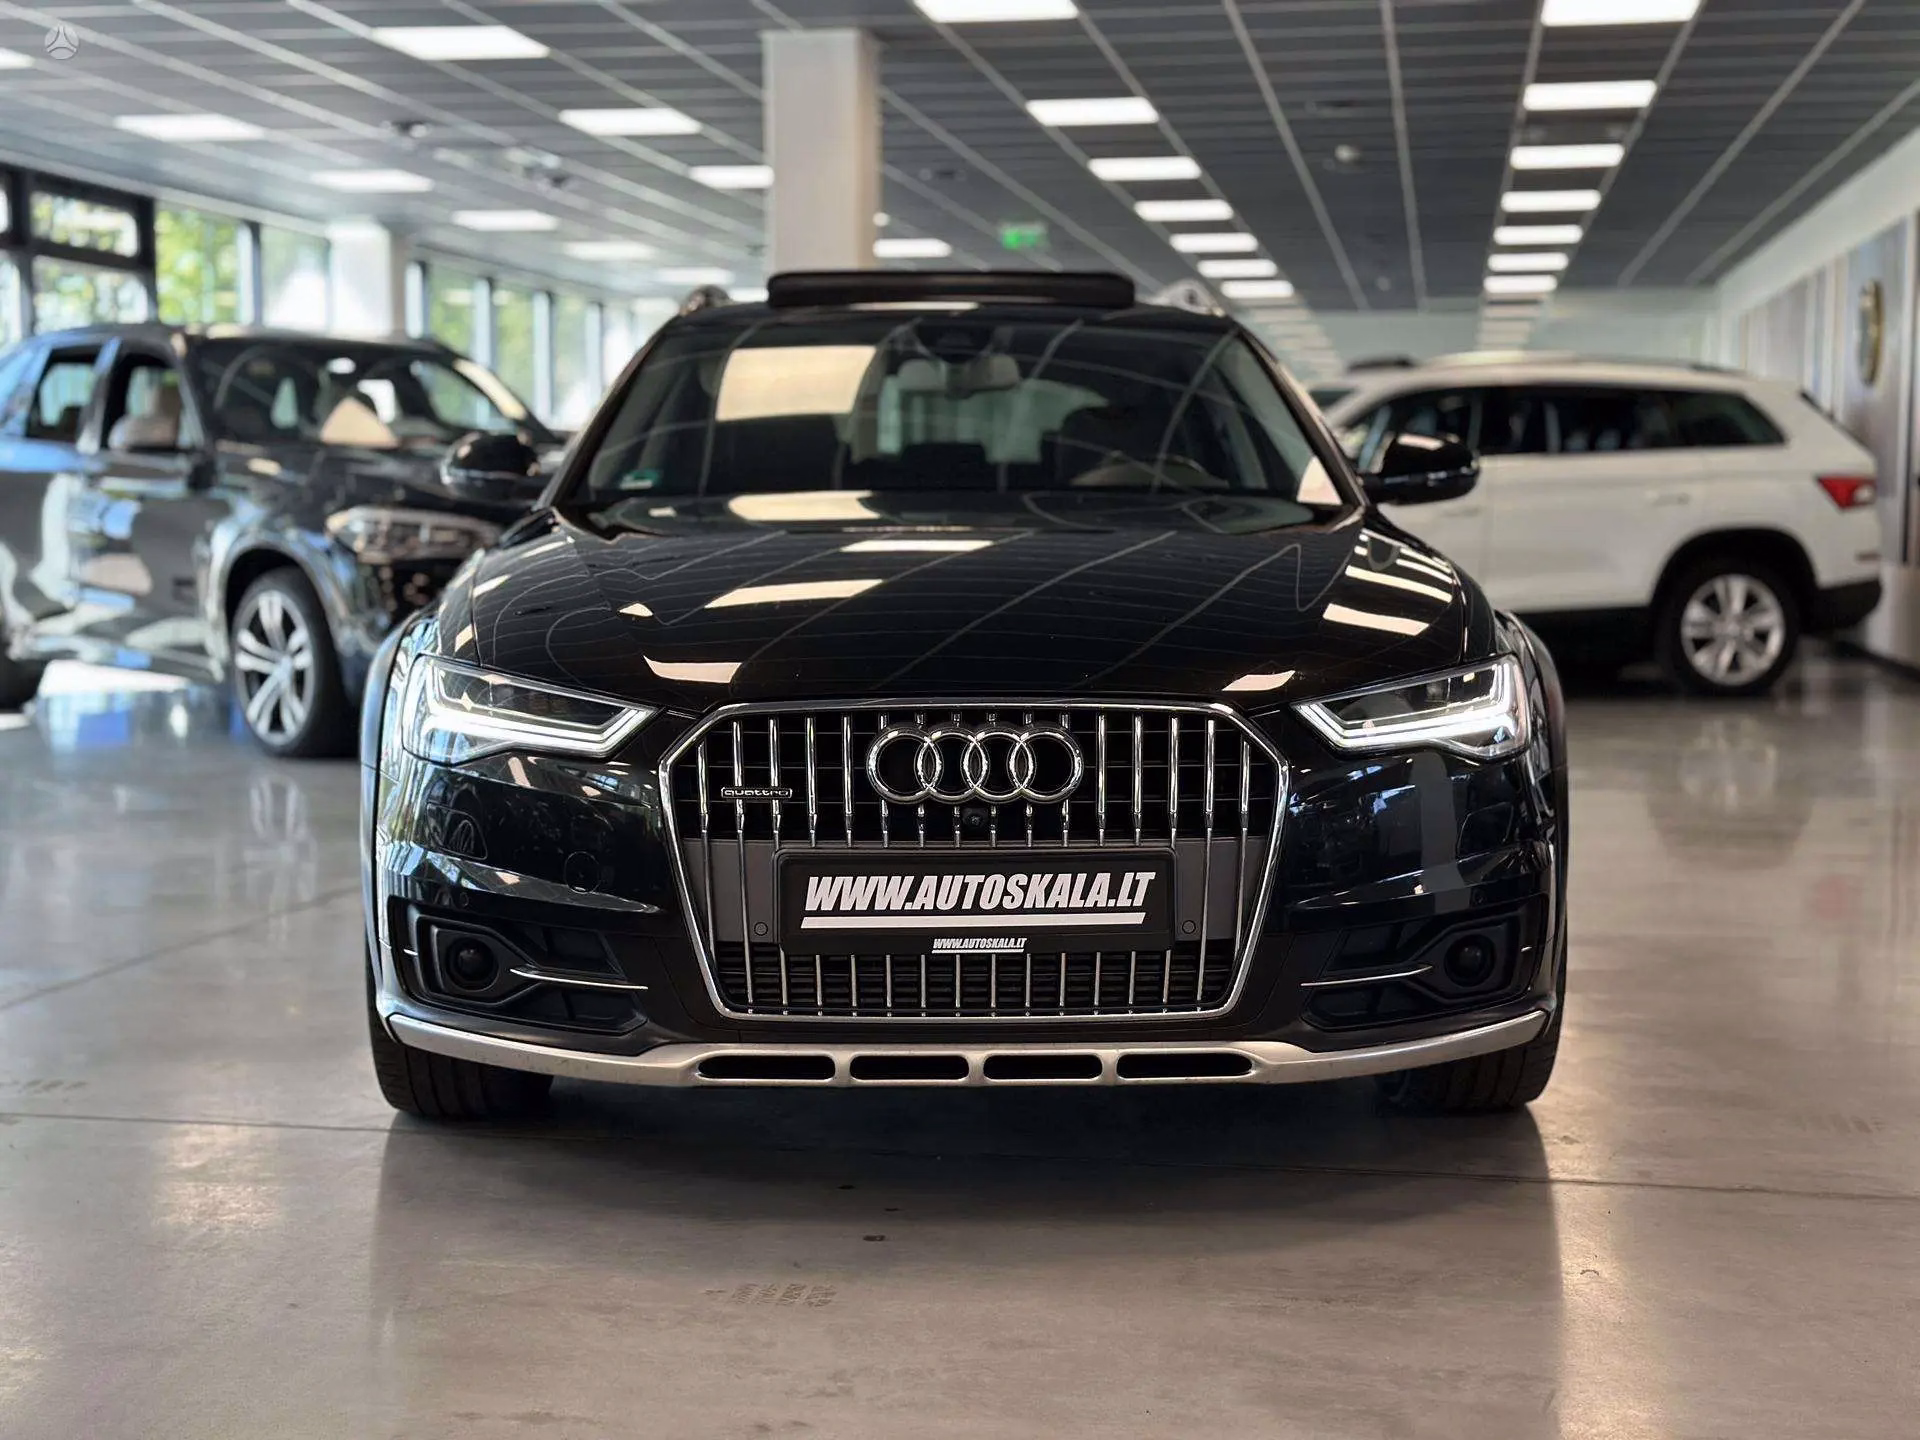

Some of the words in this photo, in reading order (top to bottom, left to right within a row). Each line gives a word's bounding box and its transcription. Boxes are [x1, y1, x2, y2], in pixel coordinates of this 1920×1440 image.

[723, 788, 790, 798] quattro
[805, 872, 1156, 911] WWW.AUTOSKALA.LT
[932, 937, 1028, 949] WWW.AUTOSKALA.LT
